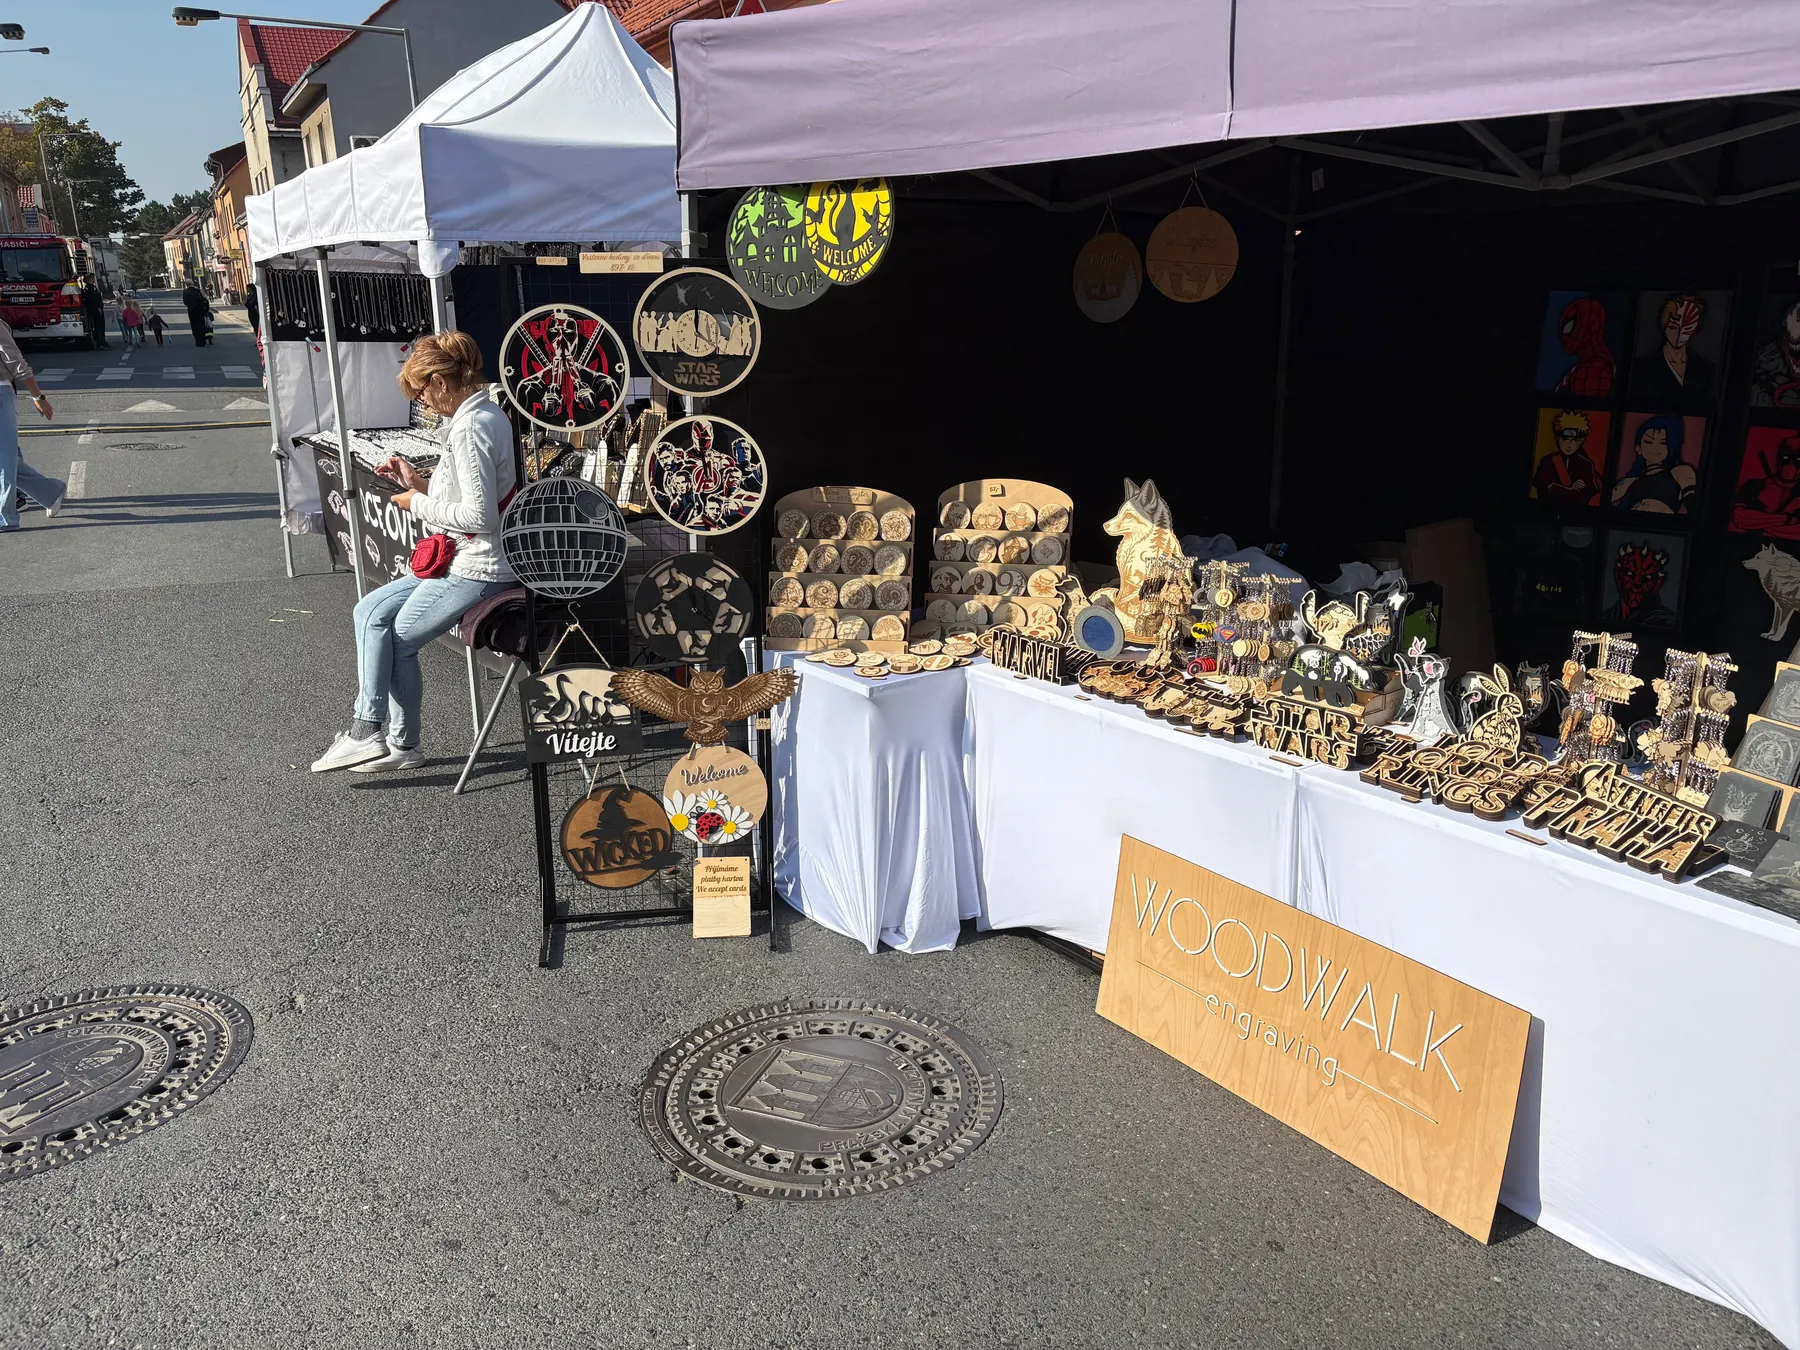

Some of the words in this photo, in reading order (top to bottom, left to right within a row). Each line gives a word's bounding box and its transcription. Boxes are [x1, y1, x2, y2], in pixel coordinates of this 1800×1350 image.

[823, 234, 877, 267] WELCOME
[743, 266, 824, 298] WELCOME
[674, 361, 721, 374] STAR
[674, 373, 721, 386] WARS
[991, 629, 1062, 687] MARVEL
[1250, 698, 1358, 745] STAR
[546, 731, 617, 758] Vítejte
[1251, 721, 1358, 770] WARS
[1381, 737, 1504, 784] LORD
[680, 763, 749, 787] Welcome
[1360, 755, 1517, 815] RINGS
[567, 827, 671, 872] WICKED
[1521, 786, 1704, 874] PRAHA
[708, 886, 728, 894] accept
[1131, 872, 1464, 1092] WOODWALK
[1205, 991, 1339, 1087] engraving
[819, 1118, 906, 1153] PRAŽSKÁ
